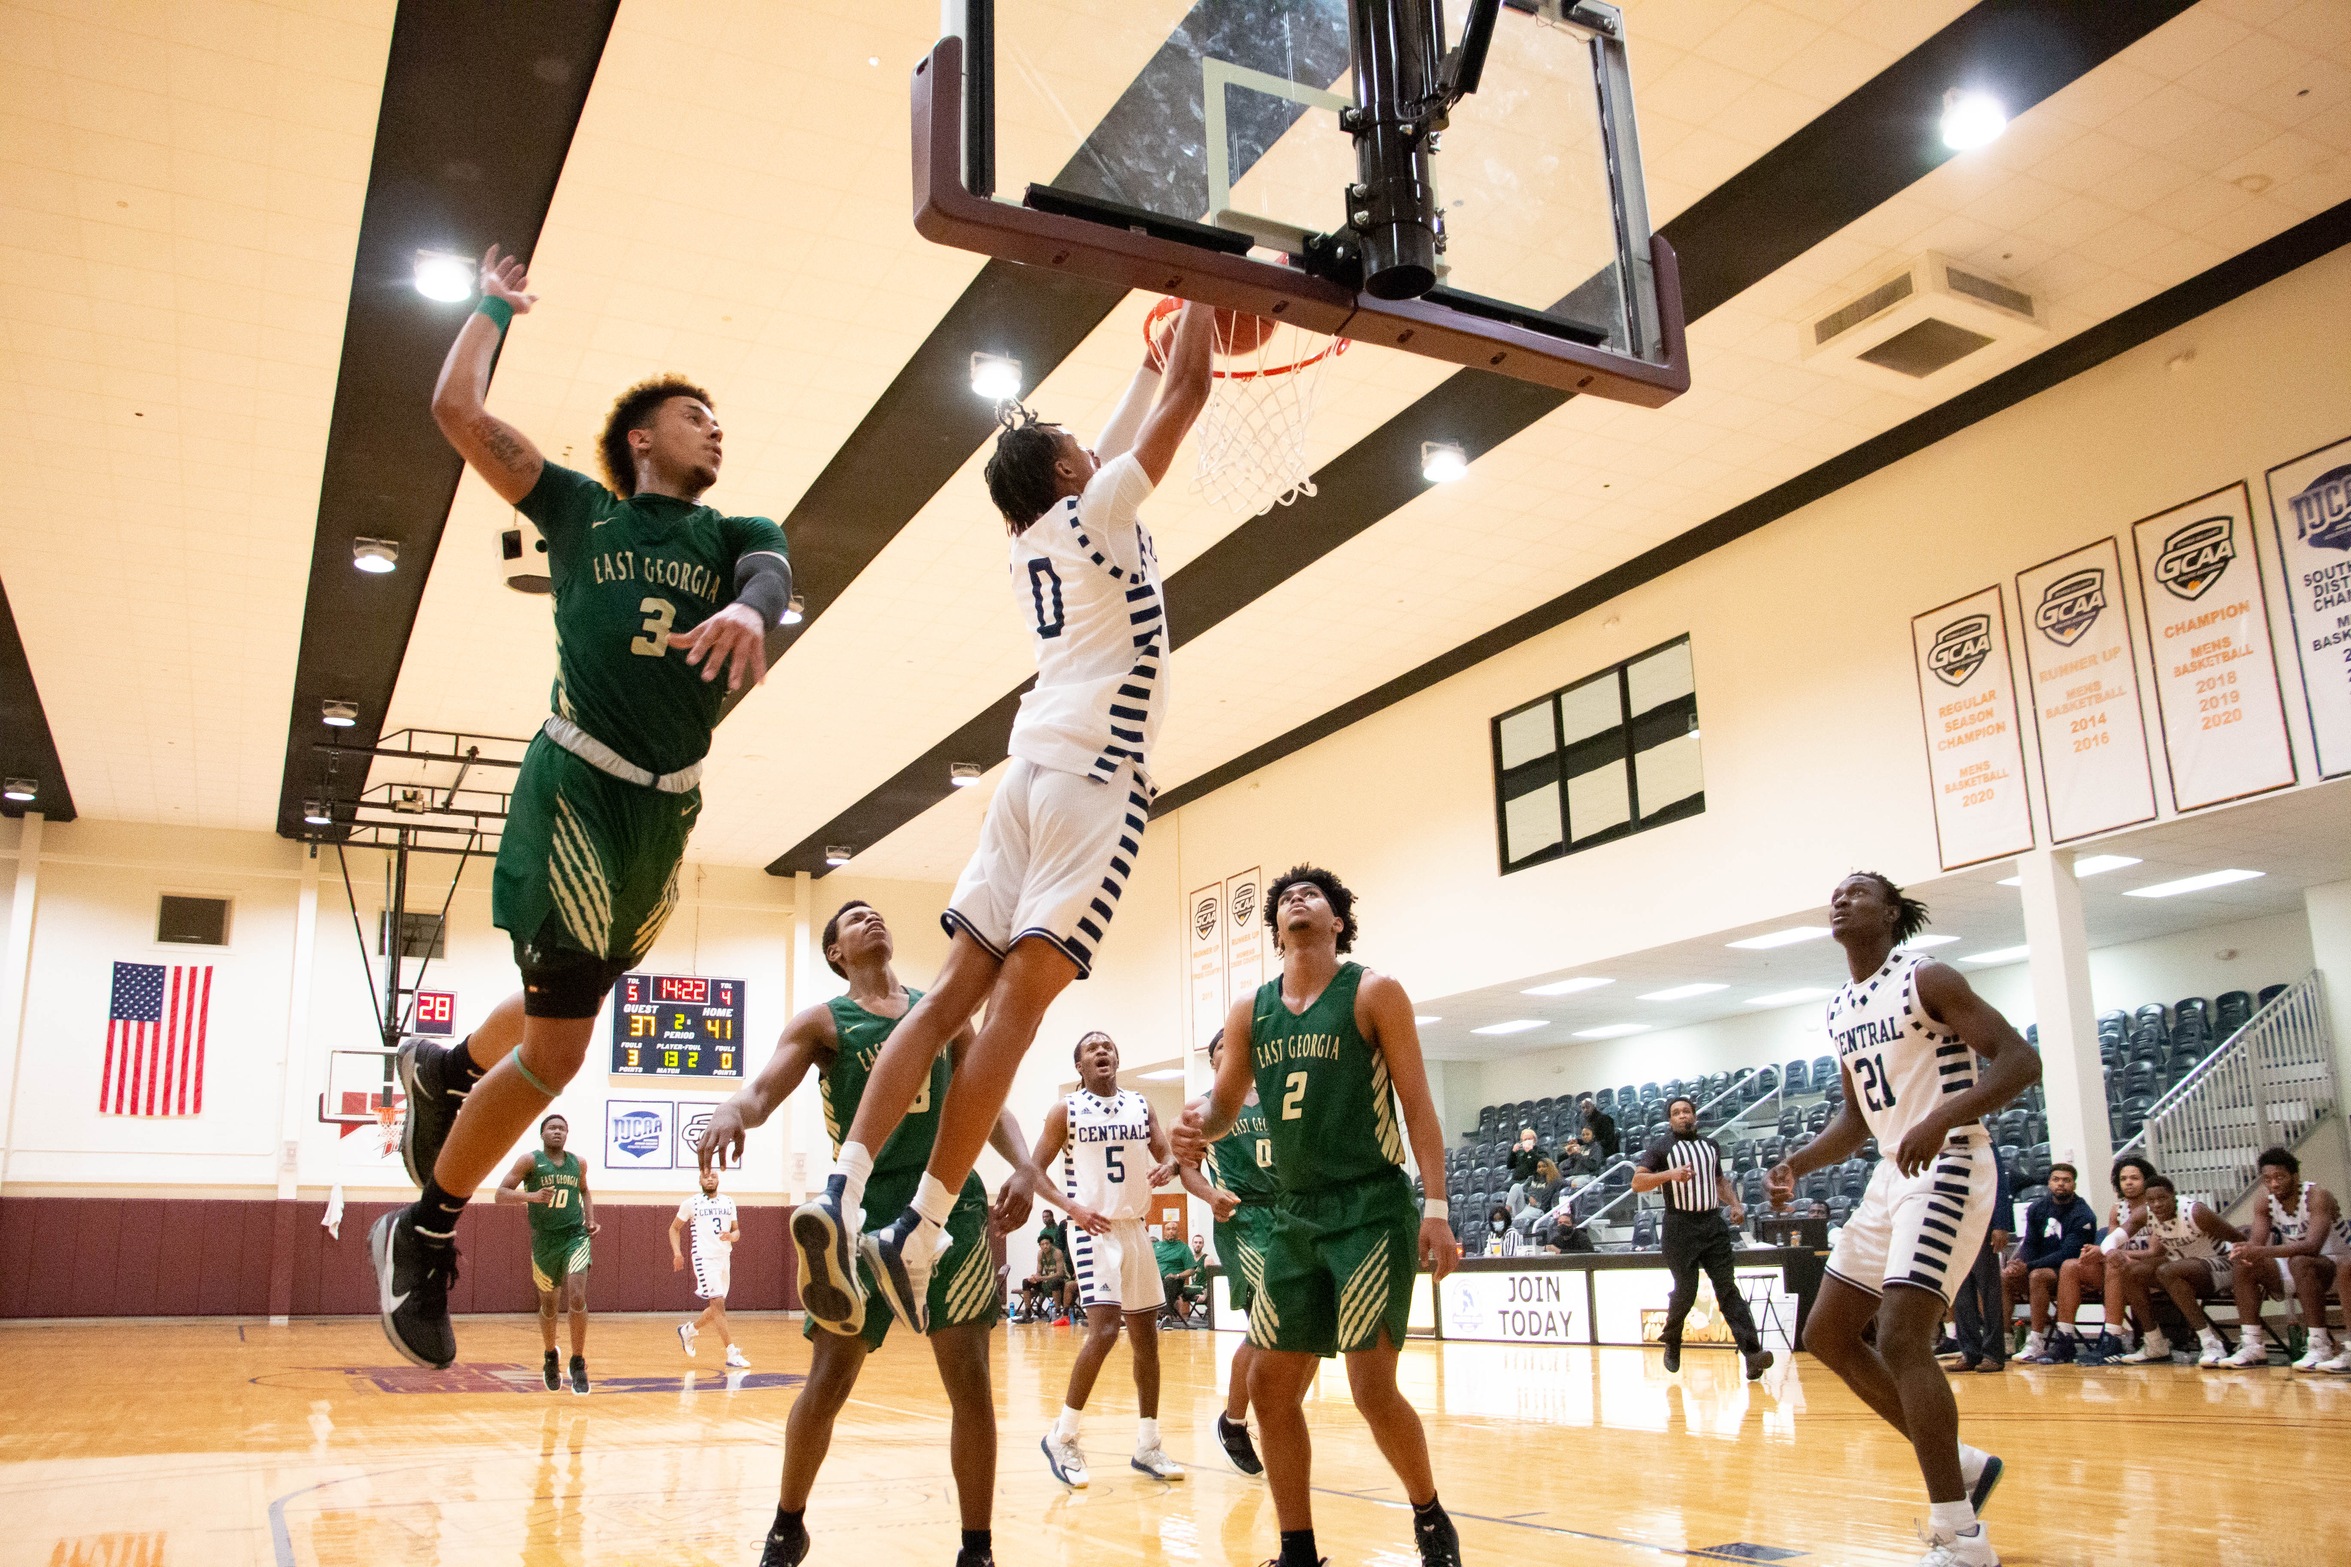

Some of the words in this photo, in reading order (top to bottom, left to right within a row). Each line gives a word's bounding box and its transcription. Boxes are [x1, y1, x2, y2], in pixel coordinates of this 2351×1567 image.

[2156, 540, 2235, 582] GCAA
[593, 551, 635, 584] EAST
[643, 557, 721, 604] GEORGIA
[1028, 556, 1065, 640] 0
[2036, 589, 2107, 629] GCAA
[630, 597, 677, 657] 3
[2163, 600, 2250, 639] CHAMPION
[1929, 634, 1991, 671] GCAA
[2190, 636, 2232, 659] MENS
[2039, 653, 2099, 684] RUNNER
[2103, 645, 2122, 663] UP
[2174, 644, 2254, 678] BASKETBALL
[2066, 680, 2102, 700] MENS
[2196, 670, 2237, 695] 2018
[1938, 689, 1997, 718] REGULAR
[2045, 685, 2128, 720] BASKETBALL
[2199, 690, 2240, 713] 2019
[1944, 707, 1994, 733] SEASON
[2070, 712, 2107, 734] 2014
[2202, 708, 2243, 731] 2020
[1937, 720, 2007, 752] CHAMPION
[2073, 732, 2110, 753] 2016
[1959, 760, 1991, 778] MENS
[1945, 768, 2009, 794] BASKETBALL
[1962, 788, 1994, 807] 2020
[628, 985, 638, 1001] 5
[662, 979, 705, 1000] 14:22
[721, 990, 731, 1006] 4
[418, 995, 451, 1021] 28
[623, 1003, 660, 1014] GUEST
[702, 1007, 734, 1017] HOME
[630, 1015, 656, 1036] 37
[674, 1013, 685, 1030] 2
[706, 1019, 732, 1040] 41
[620, 1041, 643, 1049] FOULS
[664, 1030, 695, 1039] PERIOD
[627, 1049, 639, 1066] 3
[656, 1043, 701, 1051] PLAYER-FOUL
[1256, 1038, 1283, 1069] EAST
[1288, 1033, 1340, 1061] GEORGIA
[664, 1051, 679, 1067] 13
[688, 1051, 699, 1068] 2
[721, 1052, 732, 1069] 0
[1854, 1053, 1896, 1112] 21
[1281, 1071, 1308, 1121] 2
[612, 1117, 663, 1143] NJCAA
[1078, 1124, 1147, 1142] CENTRAL
[1105, 1145, 1125, 1183] 5
[540, 1174, 554, 1186] EAST
[556, 1174, 578, 1187] GEORGIA
[548, 1188, 569, 1208] 10
[699, 1208, 732, 1216] CENTRAL
[713, 1217, 722, 1234] 3
[1508, 1276, 1560, 1303] JOIN
[1498, 1309, 1572, 1337] TODAY
